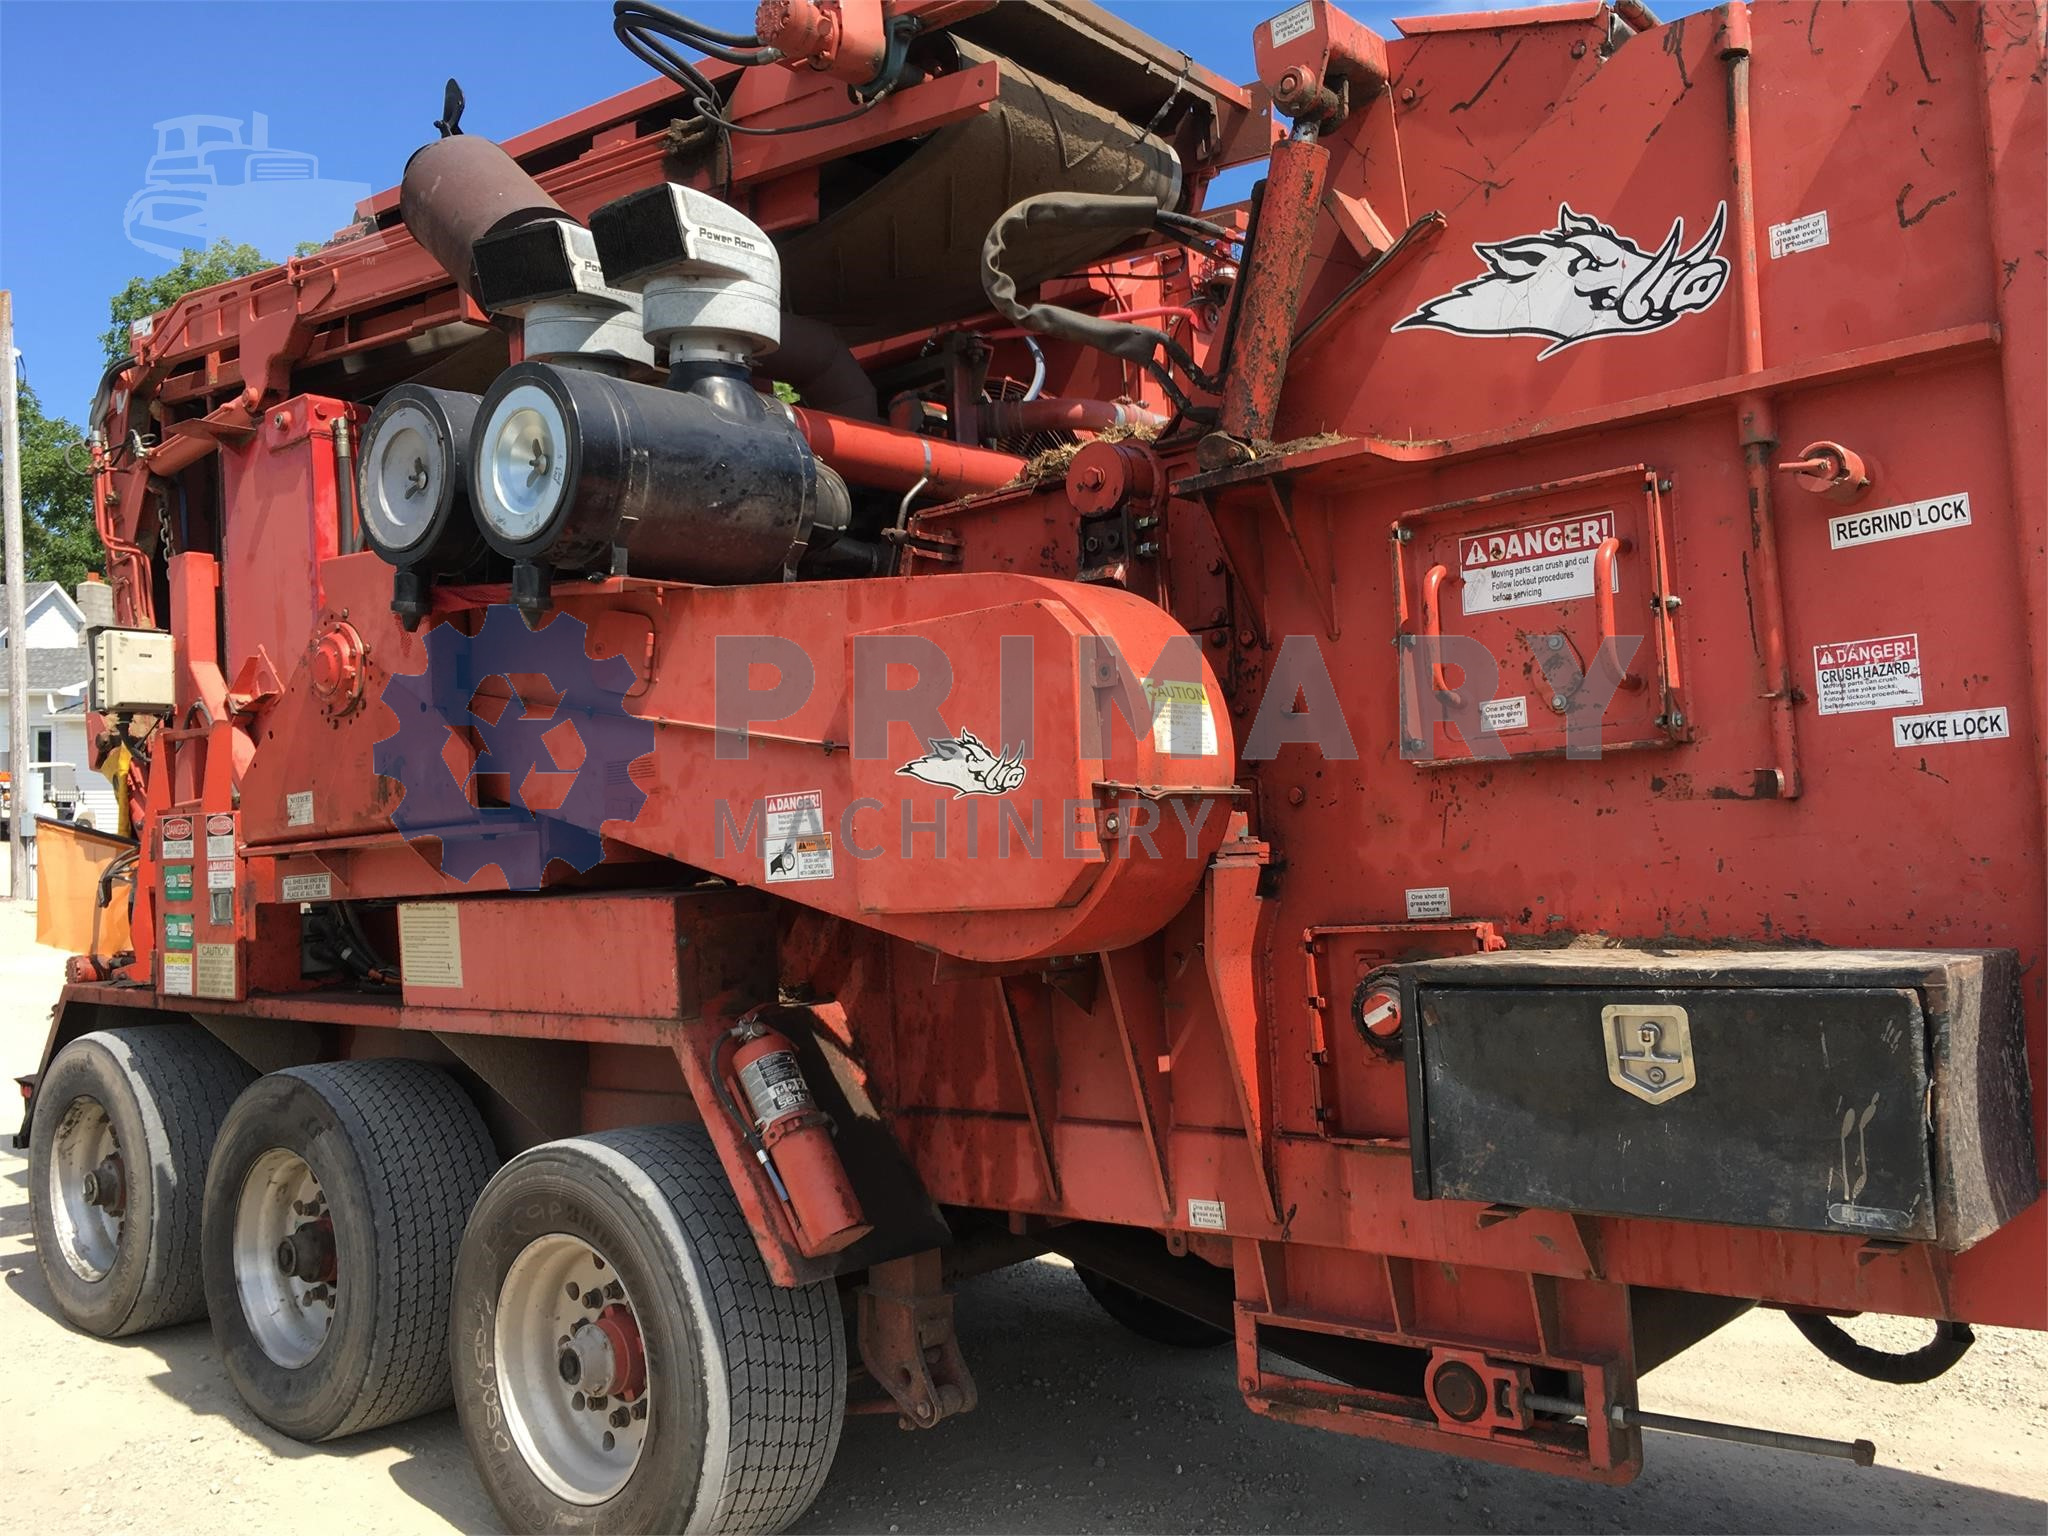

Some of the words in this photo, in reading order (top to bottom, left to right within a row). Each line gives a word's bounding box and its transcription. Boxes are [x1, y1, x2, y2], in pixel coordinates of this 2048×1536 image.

[698, 227, 732, 244] Power
[1776, 228, 1792, 237] One
[1794, 222, 1810, 232] shot
[1812, 219, 1820, 227] of
[1802, 227, 1824, 237] every
[584, 260, 603, 273] Pow
[1836, 510, 1912, 541] REGRIND
[1917, 499, 1967, 526] LOCK
[1488, 517, 1608, 562] DANGER!
[1491, 568, 1514, 580] Moving
[1515, 564, 1531, 577] parts
[1532, 563, 1544, 572] can
[1545, 558, 1563, 570] crush
[1565, 556, 1577, 568] and
[1578, 555, 1589, 566] cut
[1491, 579, 1512, 591] Follow
[1513, 575, 1537, 587] lockout
[1538, 571, 1574, 586] procedures
[1513, 587, 1542, 601] servicing
[1836, 641, 1911, 664] DANGER!
[1821, 667, 1860, 683] CRUSH
[1863, 661, 1910, 679] HAZARD
[1848, 680, 1864, 688] parts
[1861, 686, 1876, 694] yoke
[1846, 692, 1870, 701] lockout
[1484, 713, 1505, 721] grease
[1506, 710, 1523, 718] every
[1500, 704, 1513, 712] shot
[1900, 720, 1948, 740] YOKE
[1953, 715, 2003, 736] LOCK
[776, 793, 820, 811] DANGER!
